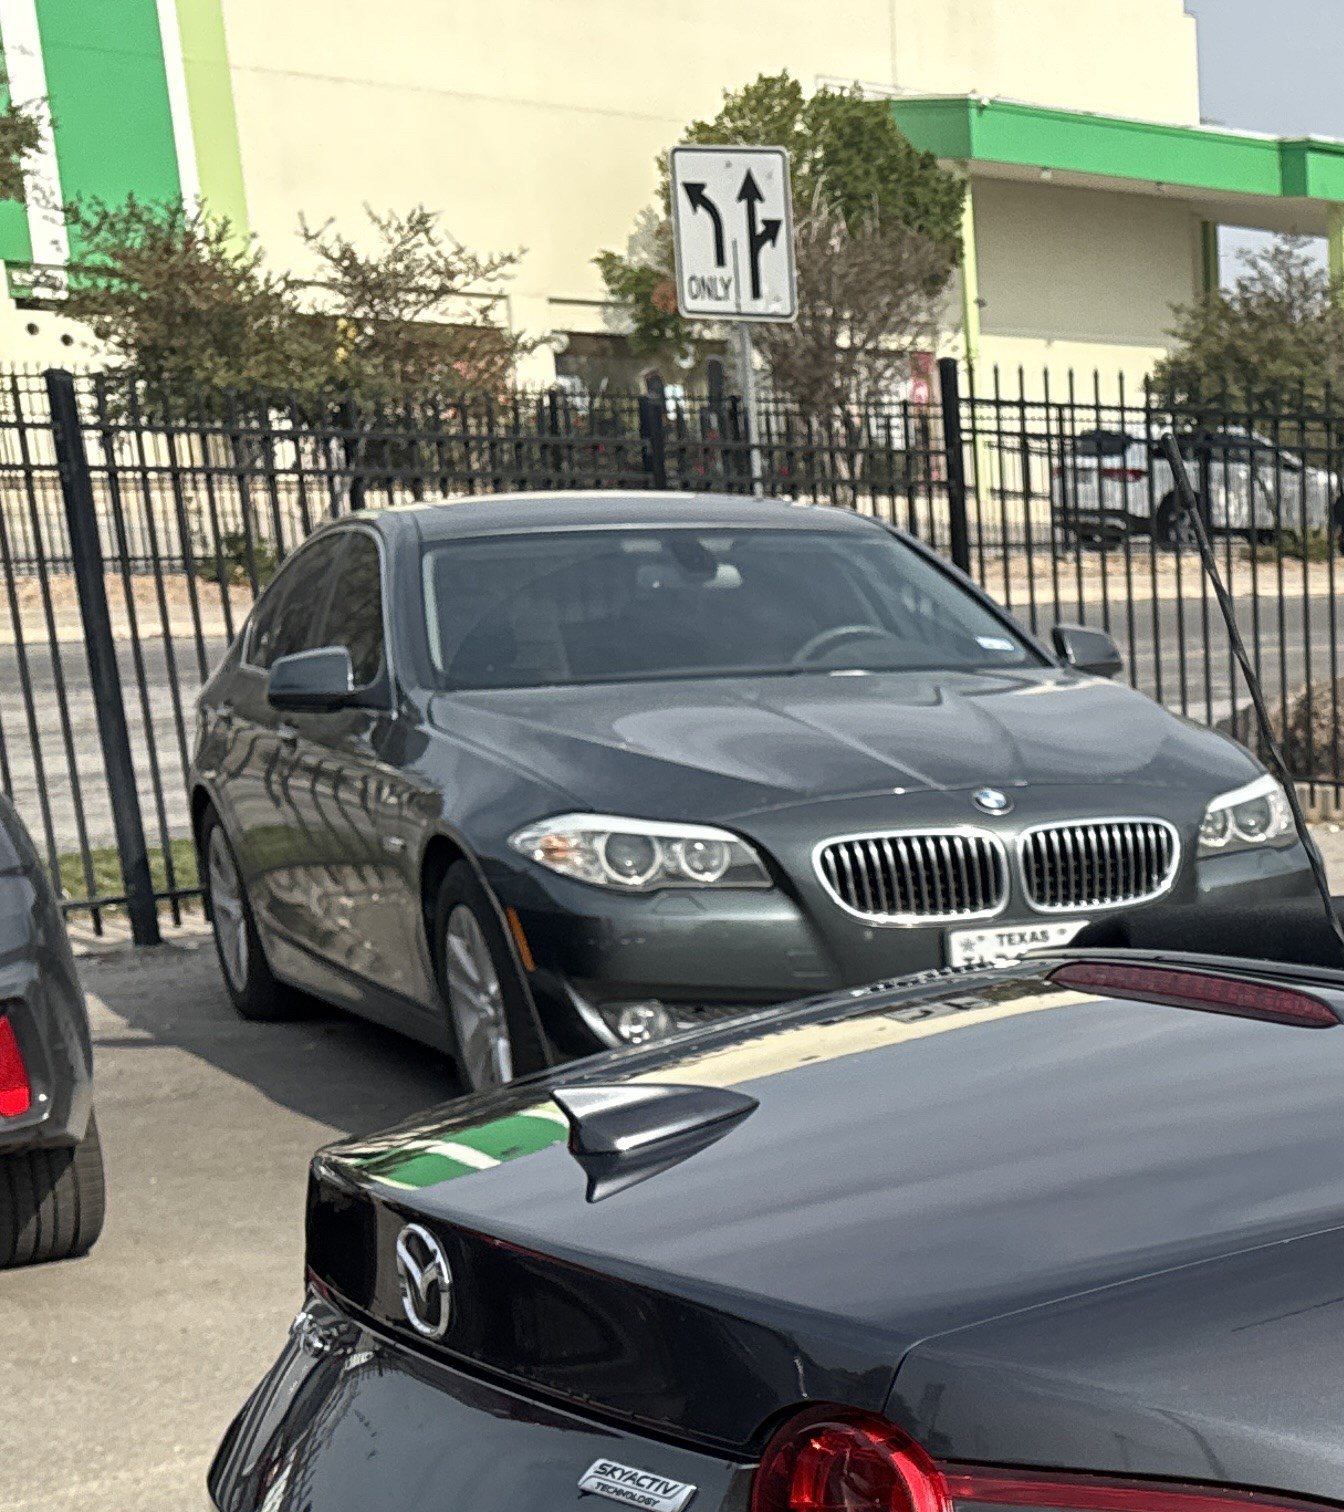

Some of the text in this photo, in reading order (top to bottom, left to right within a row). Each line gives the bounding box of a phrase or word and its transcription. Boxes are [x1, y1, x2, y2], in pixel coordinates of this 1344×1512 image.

[688, 274, 732, 301] ONLY
[996, 929, 1050, 947] TEXAS
[593, 1463, 680, 1494] SKYACTIV
[595, 1482, 660, 1507] TECHNOLOGY
